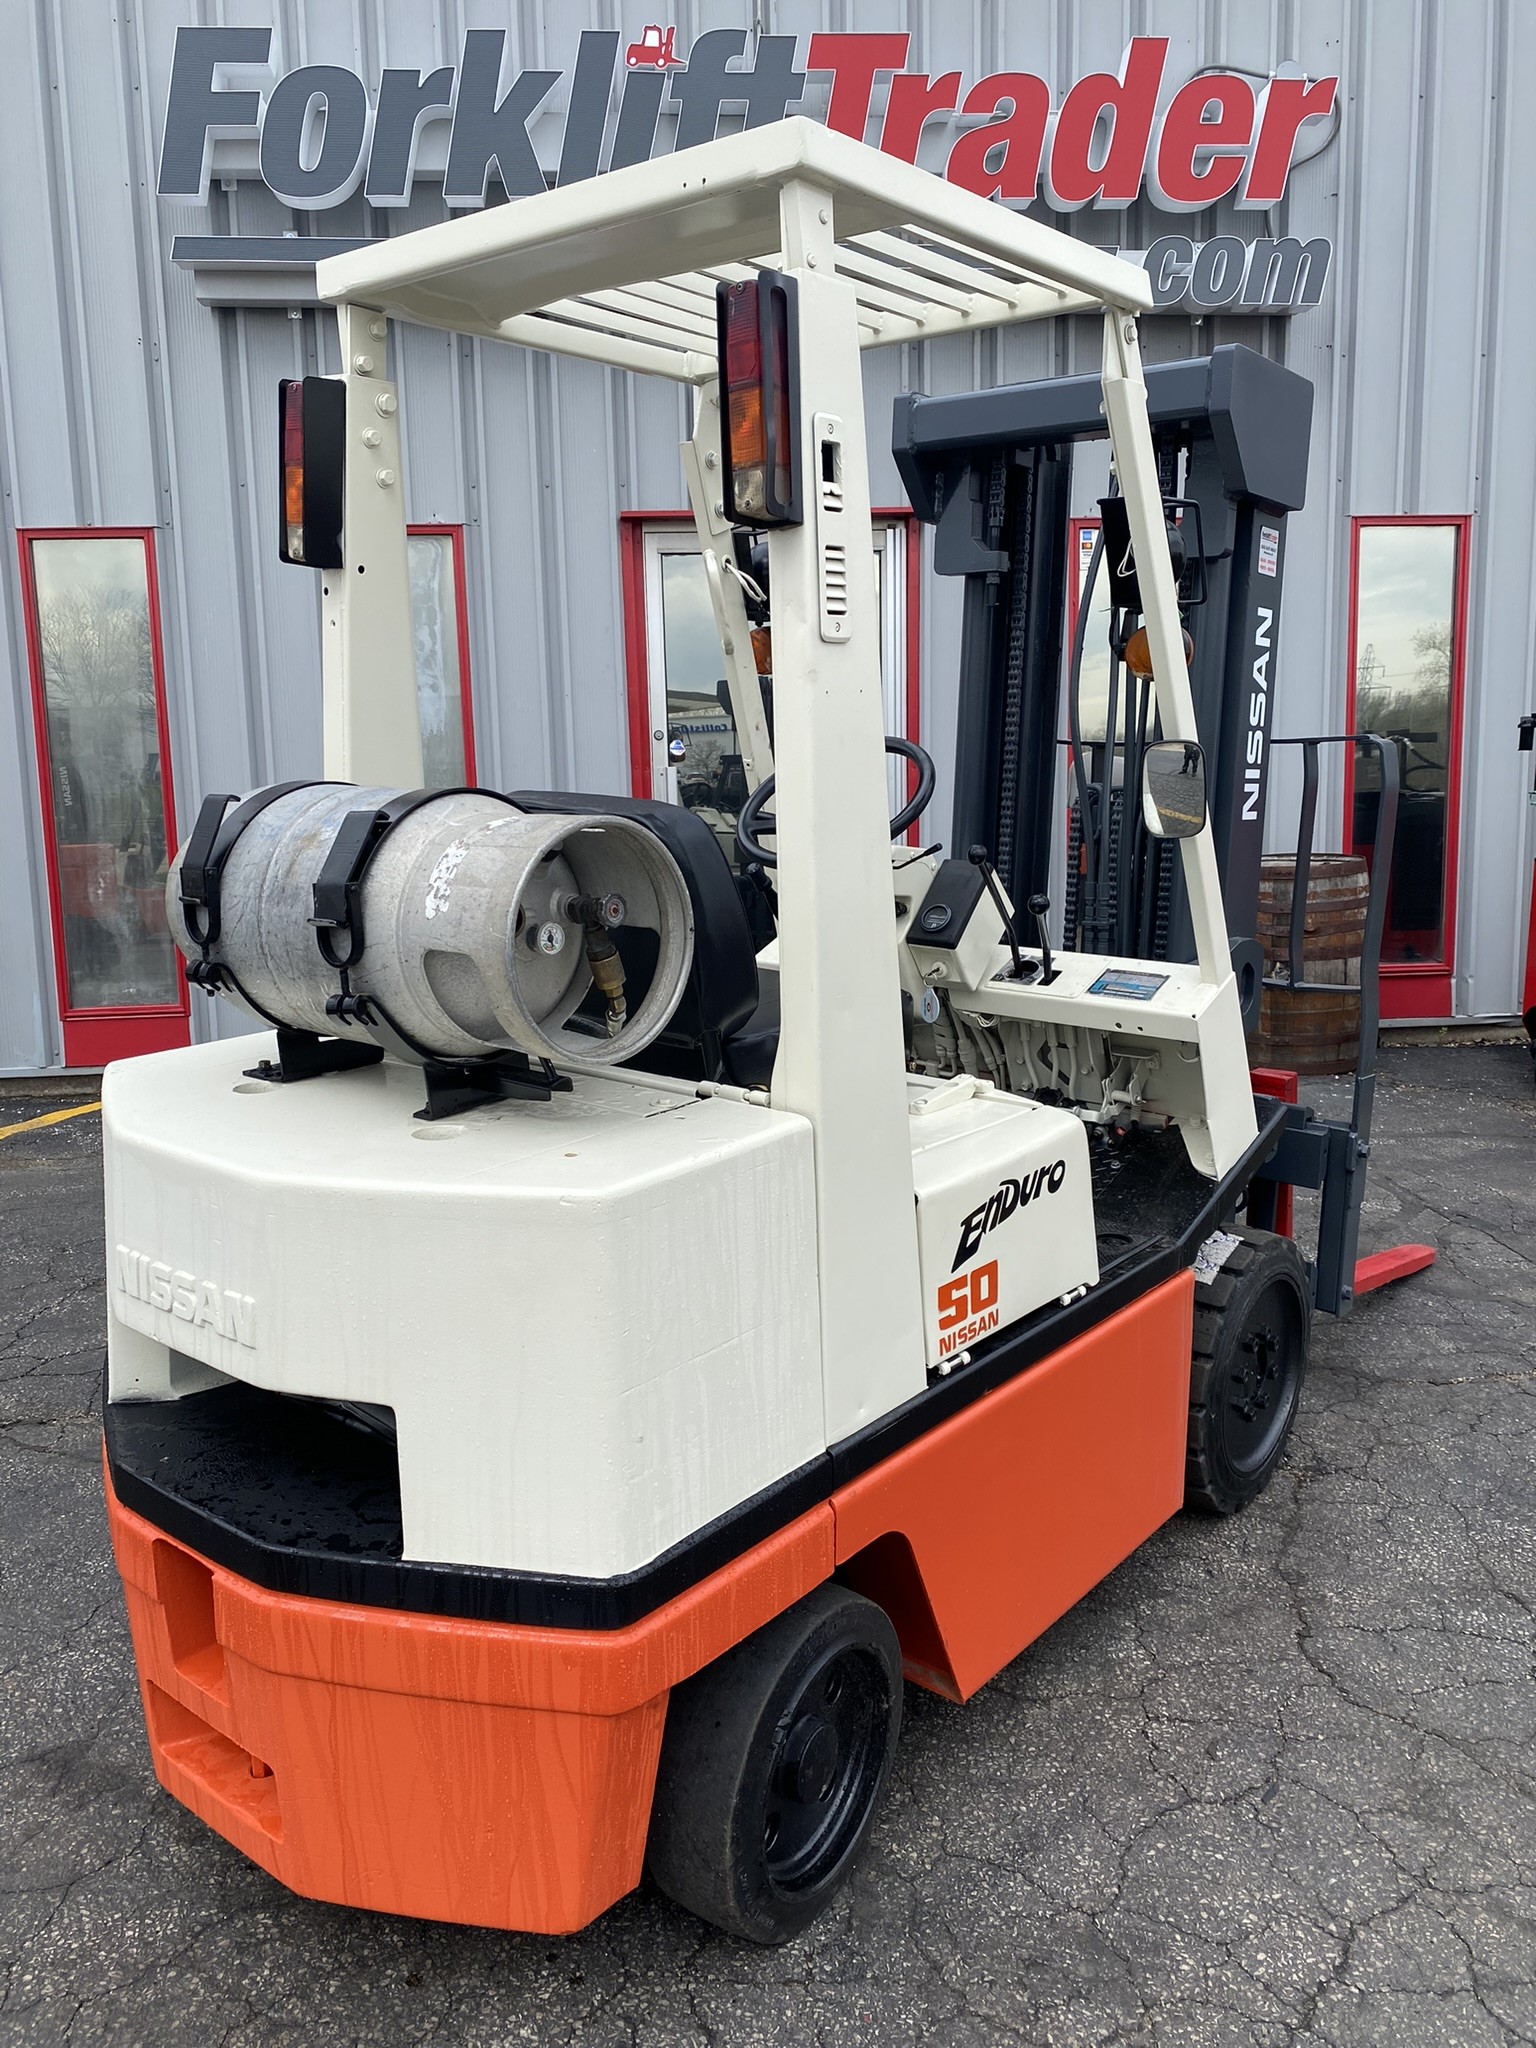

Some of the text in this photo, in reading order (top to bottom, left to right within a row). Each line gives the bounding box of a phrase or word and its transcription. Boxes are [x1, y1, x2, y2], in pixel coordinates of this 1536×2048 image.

[1241, 606, 1273, 820] NISSAN
[116, 1244, 257, 1350] NISSAN
[937, 1259, 999, 1331] 50
[938, 1308, 1000, 1357] NISSAN
